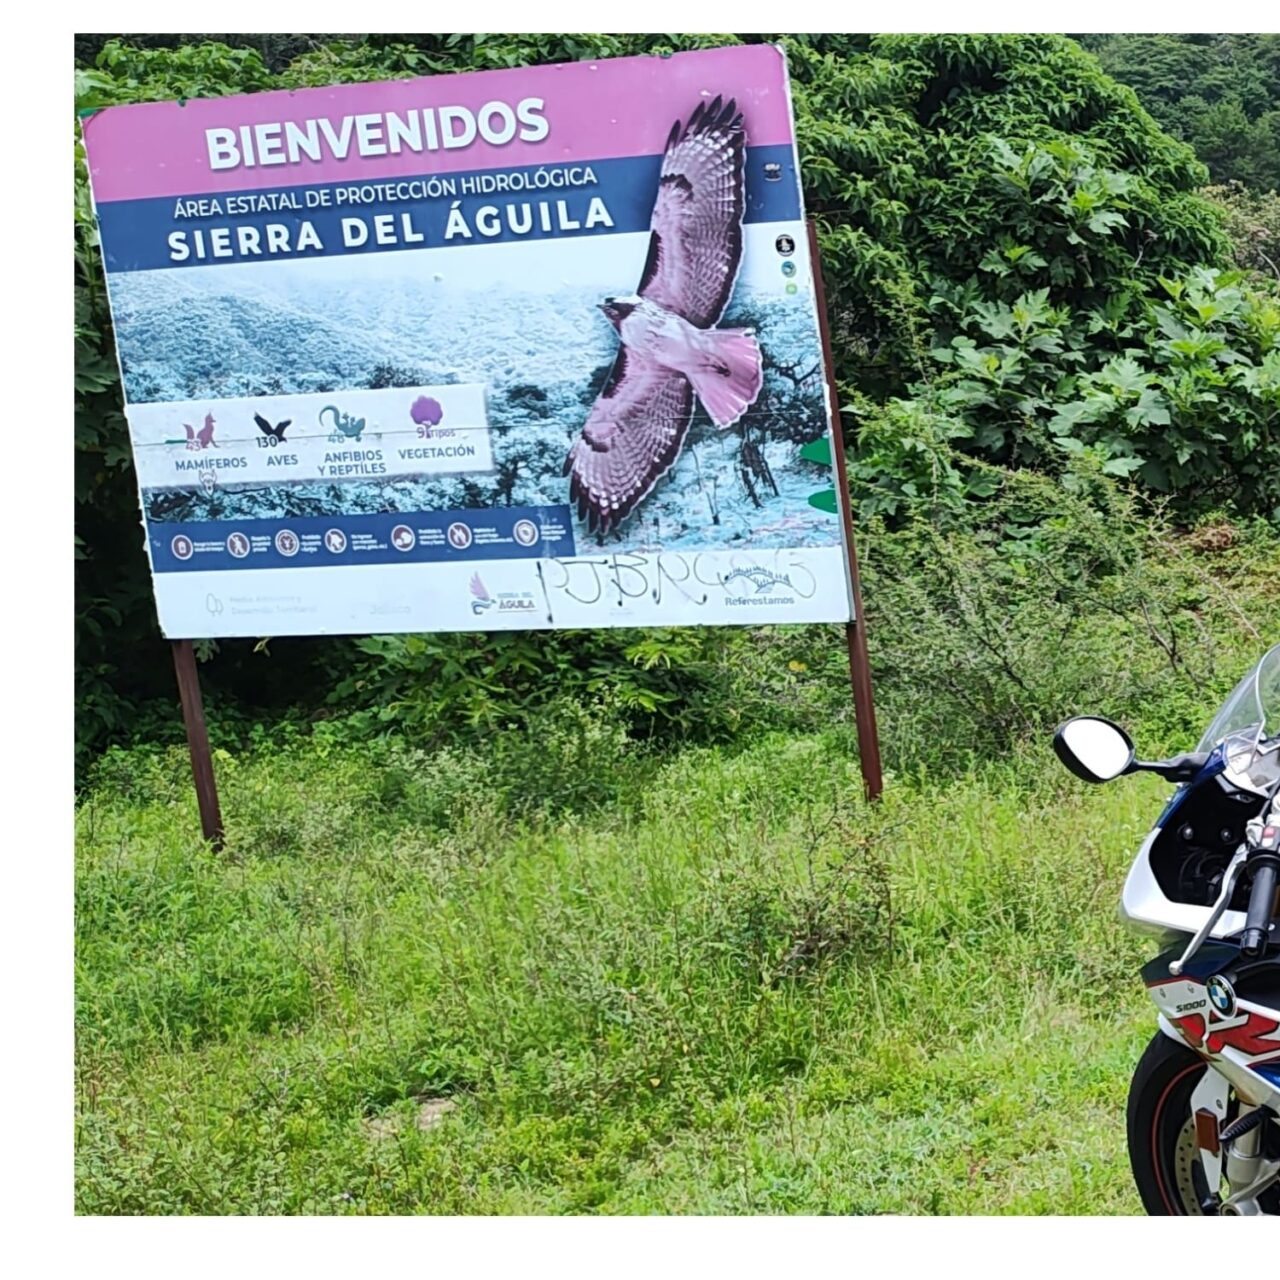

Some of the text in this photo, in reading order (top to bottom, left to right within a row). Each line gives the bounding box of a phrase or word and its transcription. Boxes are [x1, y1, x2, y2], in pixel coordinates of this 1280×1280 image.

[205, 97, 550, 171] BIENVENIDOS
[174, 165, 598, 219] ÁREA ESTATAL DE PROTECCIÓN HIDROLÓGICA
[167, 197, 616, 262] SIERRA DEL ÁGUILA
[256, 435, 278, 449] 130
[266, 454, 299, 467] AVES
[323, 449, 384, 464] ANFIBIOS
[398, 444, 477, 461] VEGETACIÓN
[175, 455, 249, 472] MAMÍFEROS
[317, 465, 328, 477] Y
[1176, 999, 1207, 1013] S1000
